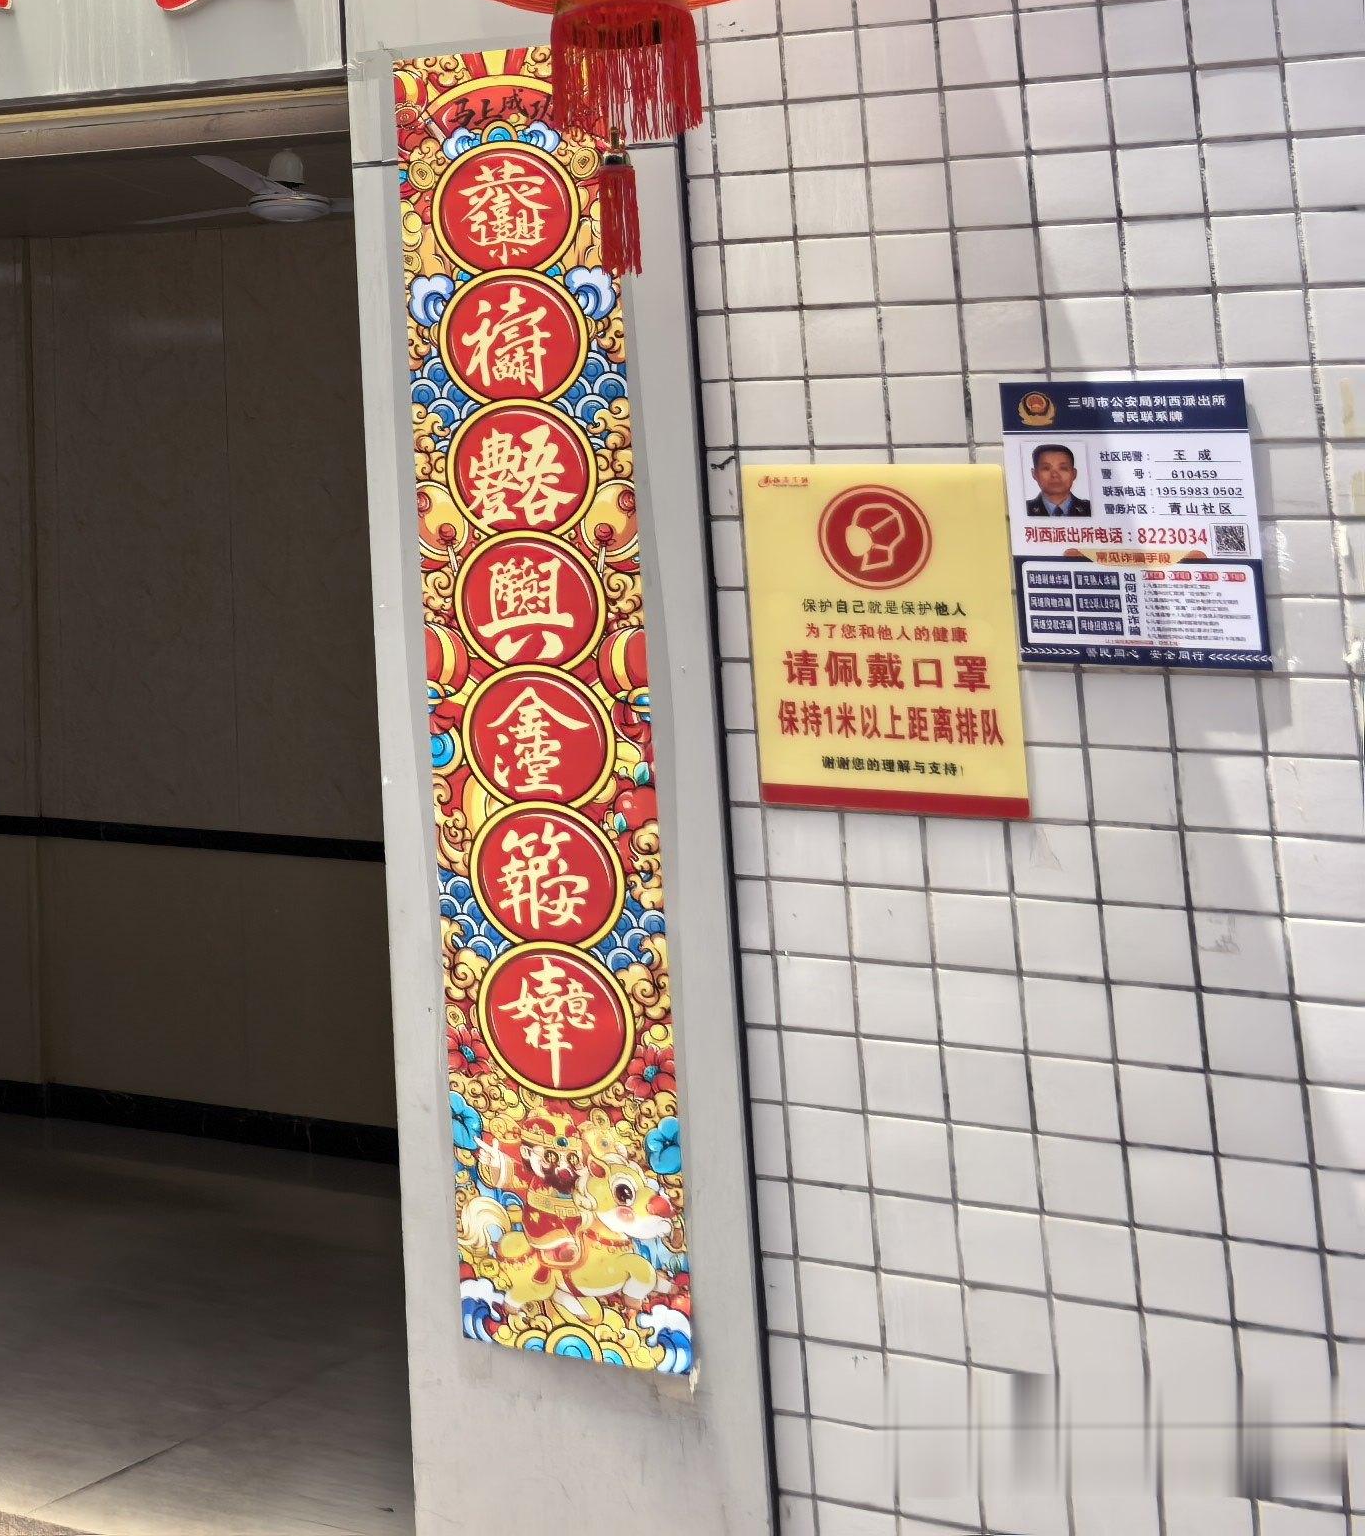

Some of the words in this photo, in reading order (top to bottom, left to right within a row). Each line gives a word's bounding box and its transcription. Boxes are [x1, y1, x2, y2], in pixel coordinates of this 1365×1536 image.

[1068, 394, 1226, 408] 三明市公安局列西派出所
[1111, 411, 1183, 424] 警民联系牌
[1168, 502, 1232, 515] 青山社区
[802, 598, 967, 617] 保护自己就是保护他人
[805, 623, 968, 644] 为了您和他人的健康
[782, 650, 992, 692] 请佩戴口罩
[777, 699, 1005, 747] 保持1米以上距离排队
